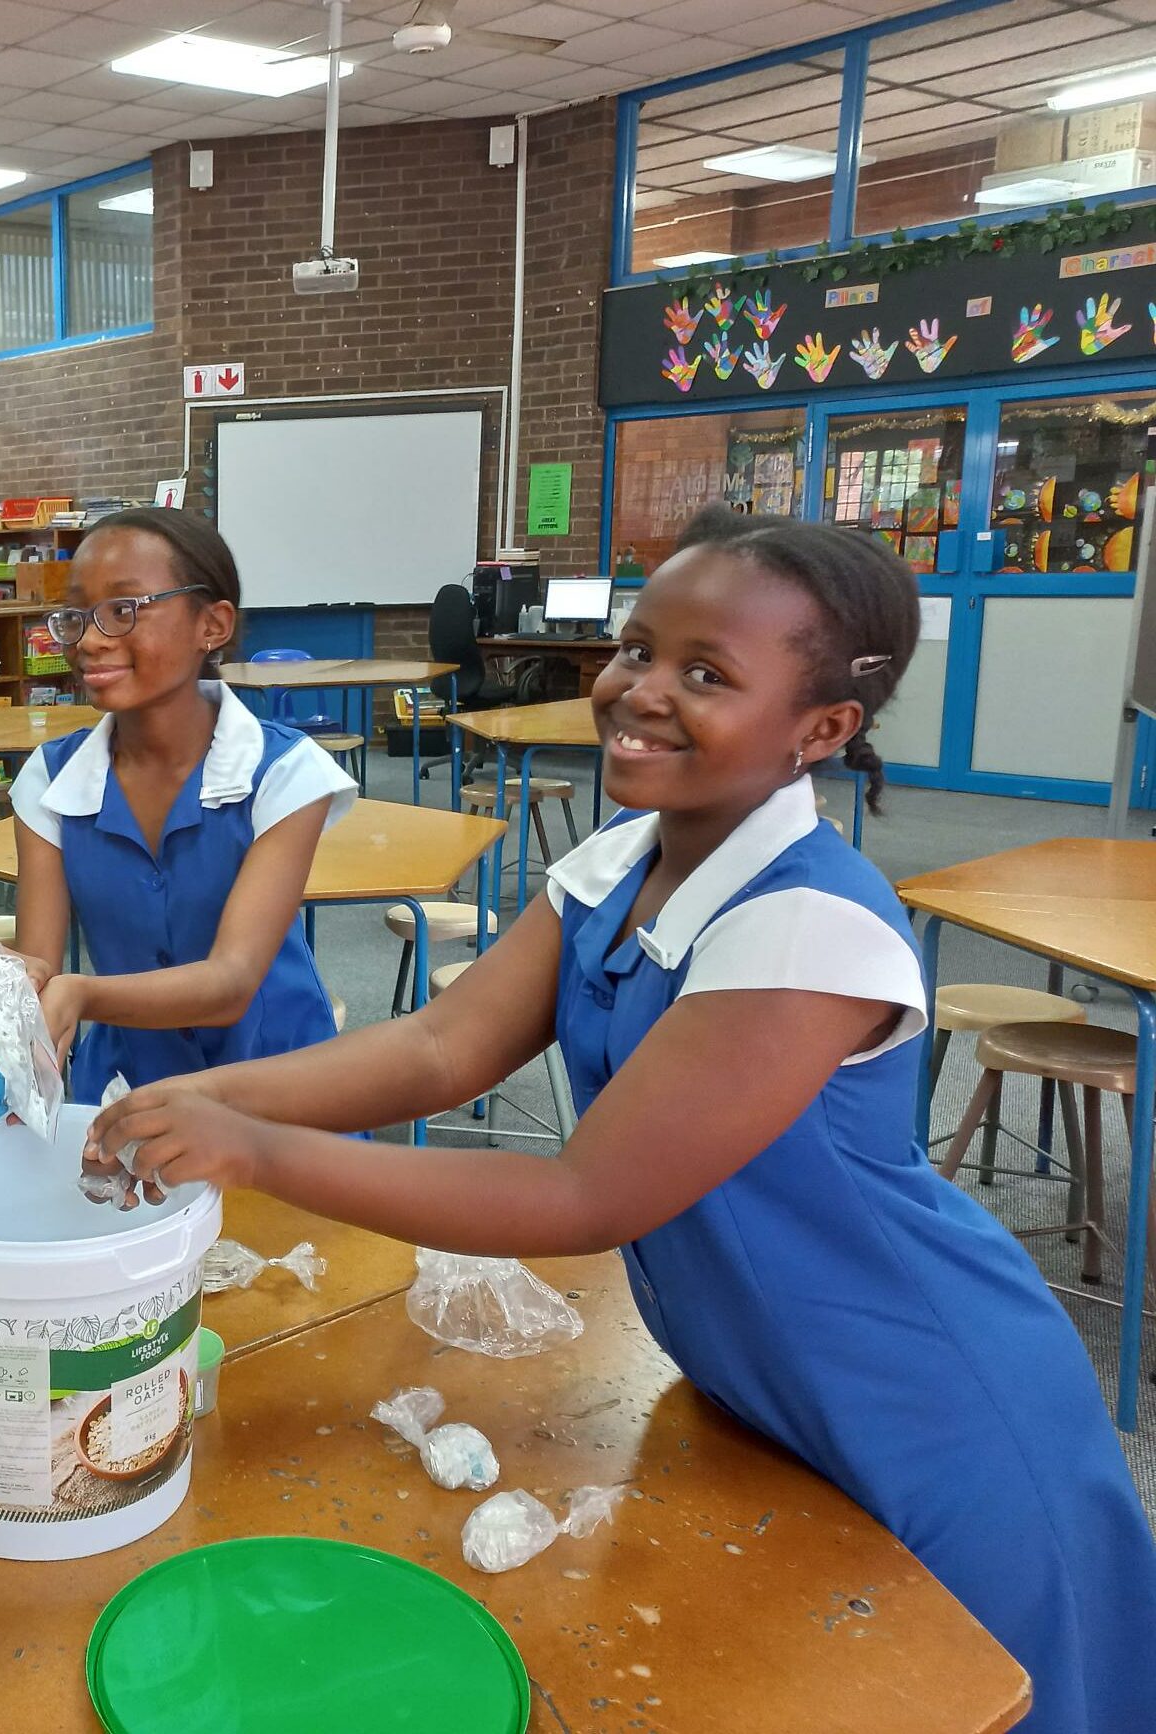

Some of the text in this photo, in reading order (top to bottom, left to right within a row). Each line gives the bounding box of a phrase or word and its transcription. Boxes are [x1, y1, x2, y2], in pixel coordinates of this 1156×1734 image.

[131, 1332, 169, 1358] LIFESTYLE
[140, 1346, 162, 1362] FOOD
[126, 1369, 171, 1398] ROLLED
[134, 1383, 164, 1405] OATS
